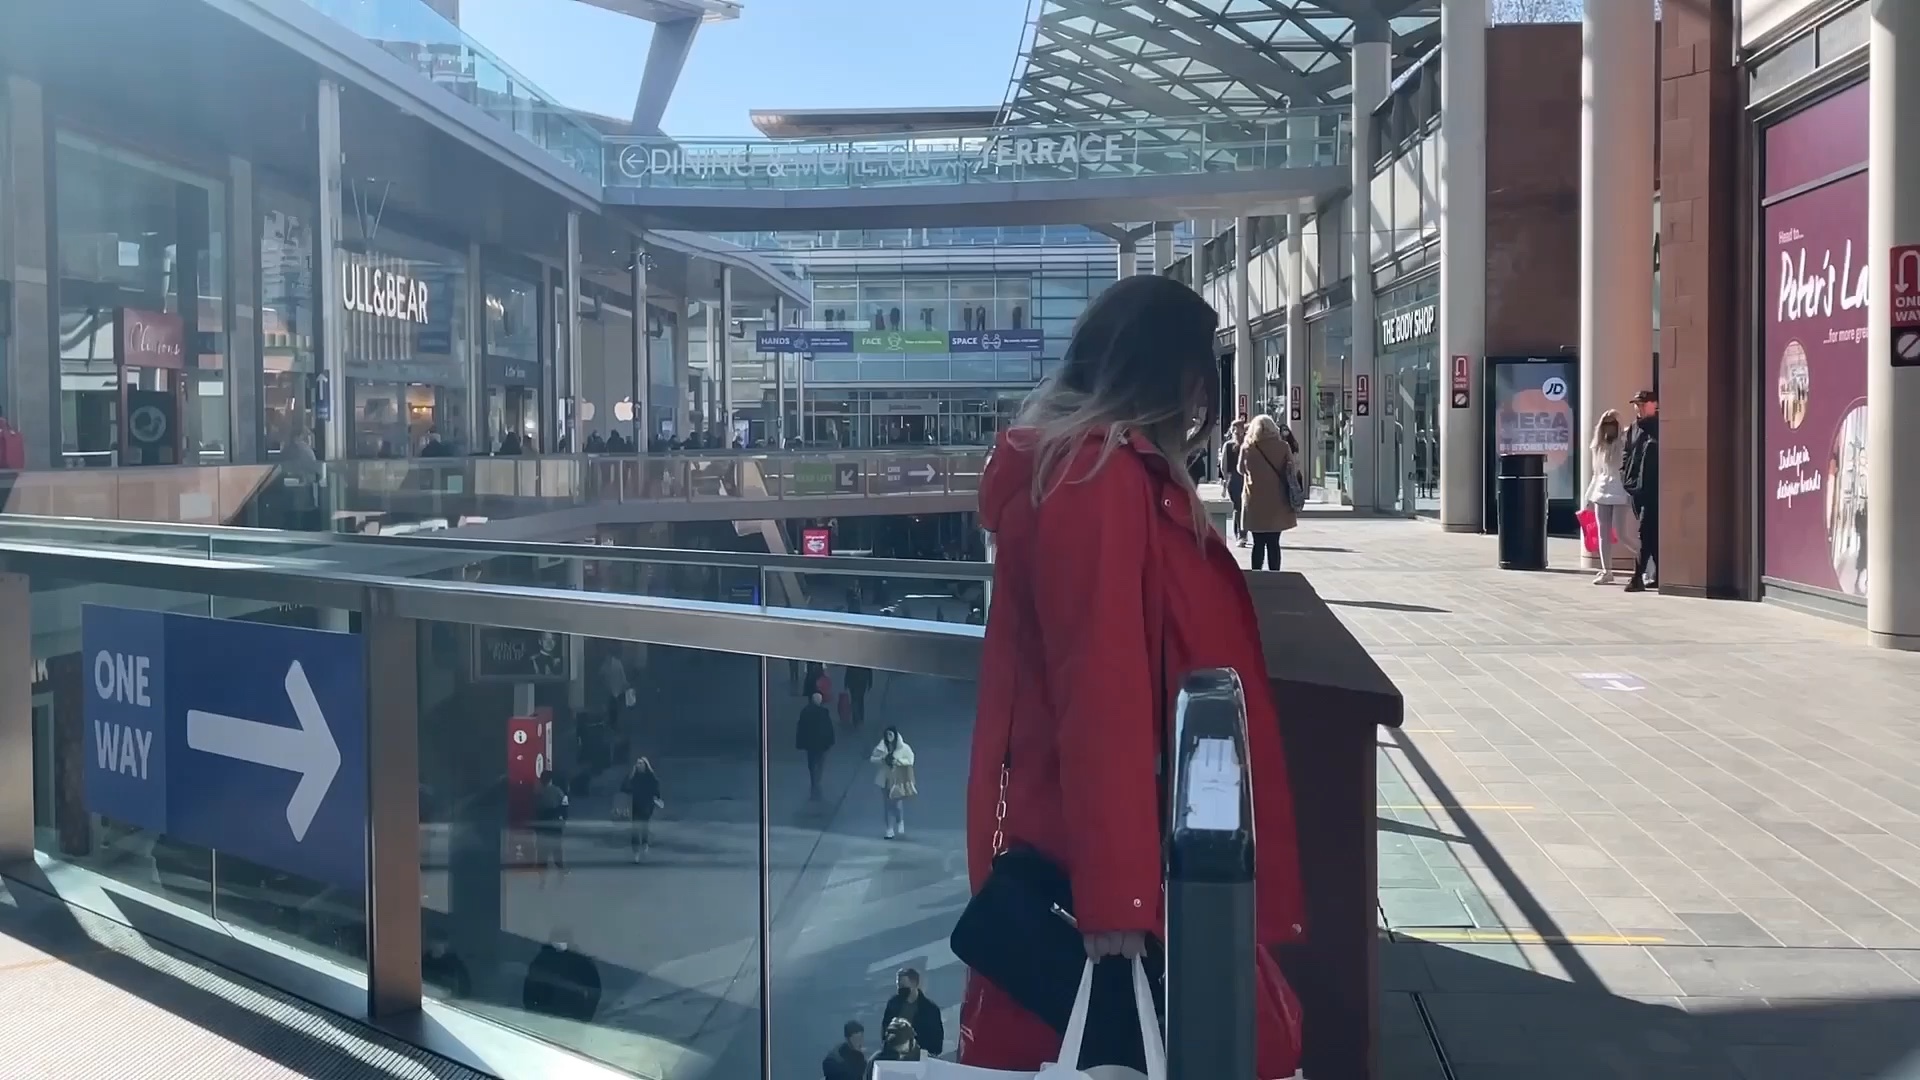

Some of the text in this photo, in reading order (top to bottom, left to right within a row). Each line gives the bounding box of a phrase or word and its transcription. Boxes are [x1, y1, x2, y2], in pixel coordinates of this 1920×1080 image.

[651, 147, 754, 177] DINING
[766, 151, 787, 177] &
[977, 134, 1123, 169] TERRACE
[1778, 247, 1836, 322] Peter's
[1383, 318, 1395, 345] THE
[1396, 311, 1413, 342] BODY
[1839, 329, 1855, 341] more
[761, 337, 790, 345] HANDS
[862, 337, 881, 345] FACE
[952, 337, 978, 345] SPACE
[1545, 383, 1564, 395] JD
[94, 649, 151, 707] ONE
[94, 719, 152, 781] WAY
